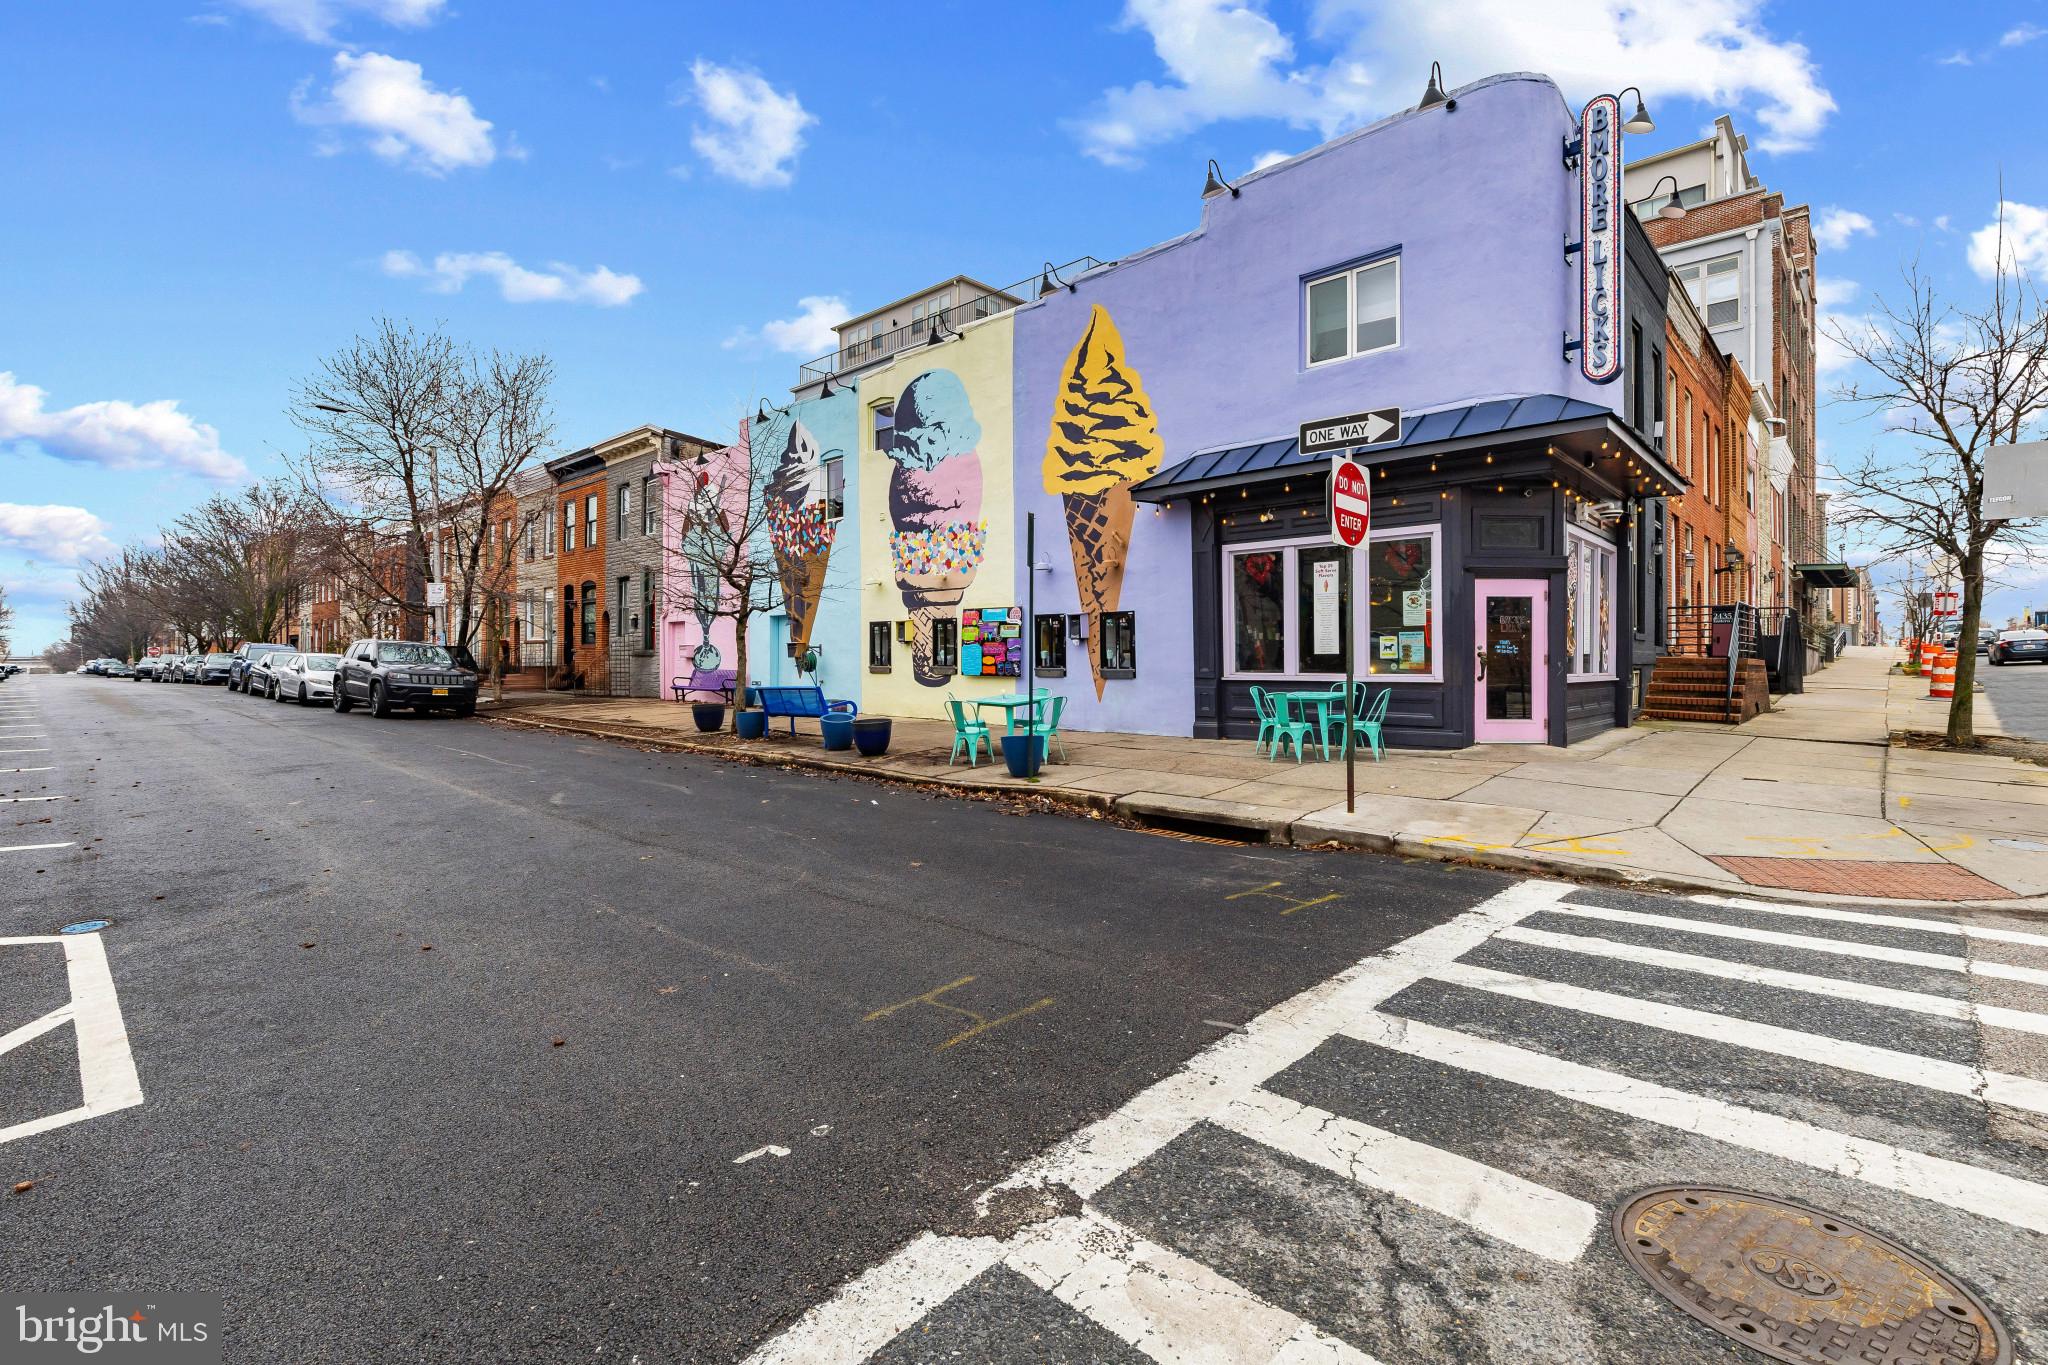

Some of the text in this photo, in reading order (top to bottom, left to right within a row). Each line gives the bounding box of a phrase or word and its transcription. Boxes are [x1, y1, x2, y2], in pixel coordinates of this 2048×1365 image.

[1590, 105, 1611, 369] BMORE LICKS
[1309, 422, 1368, 444] ONE WAY
[1338, 475, 1365, 497] DO NOT
[1340, 514, 1362, 532] ENTER
